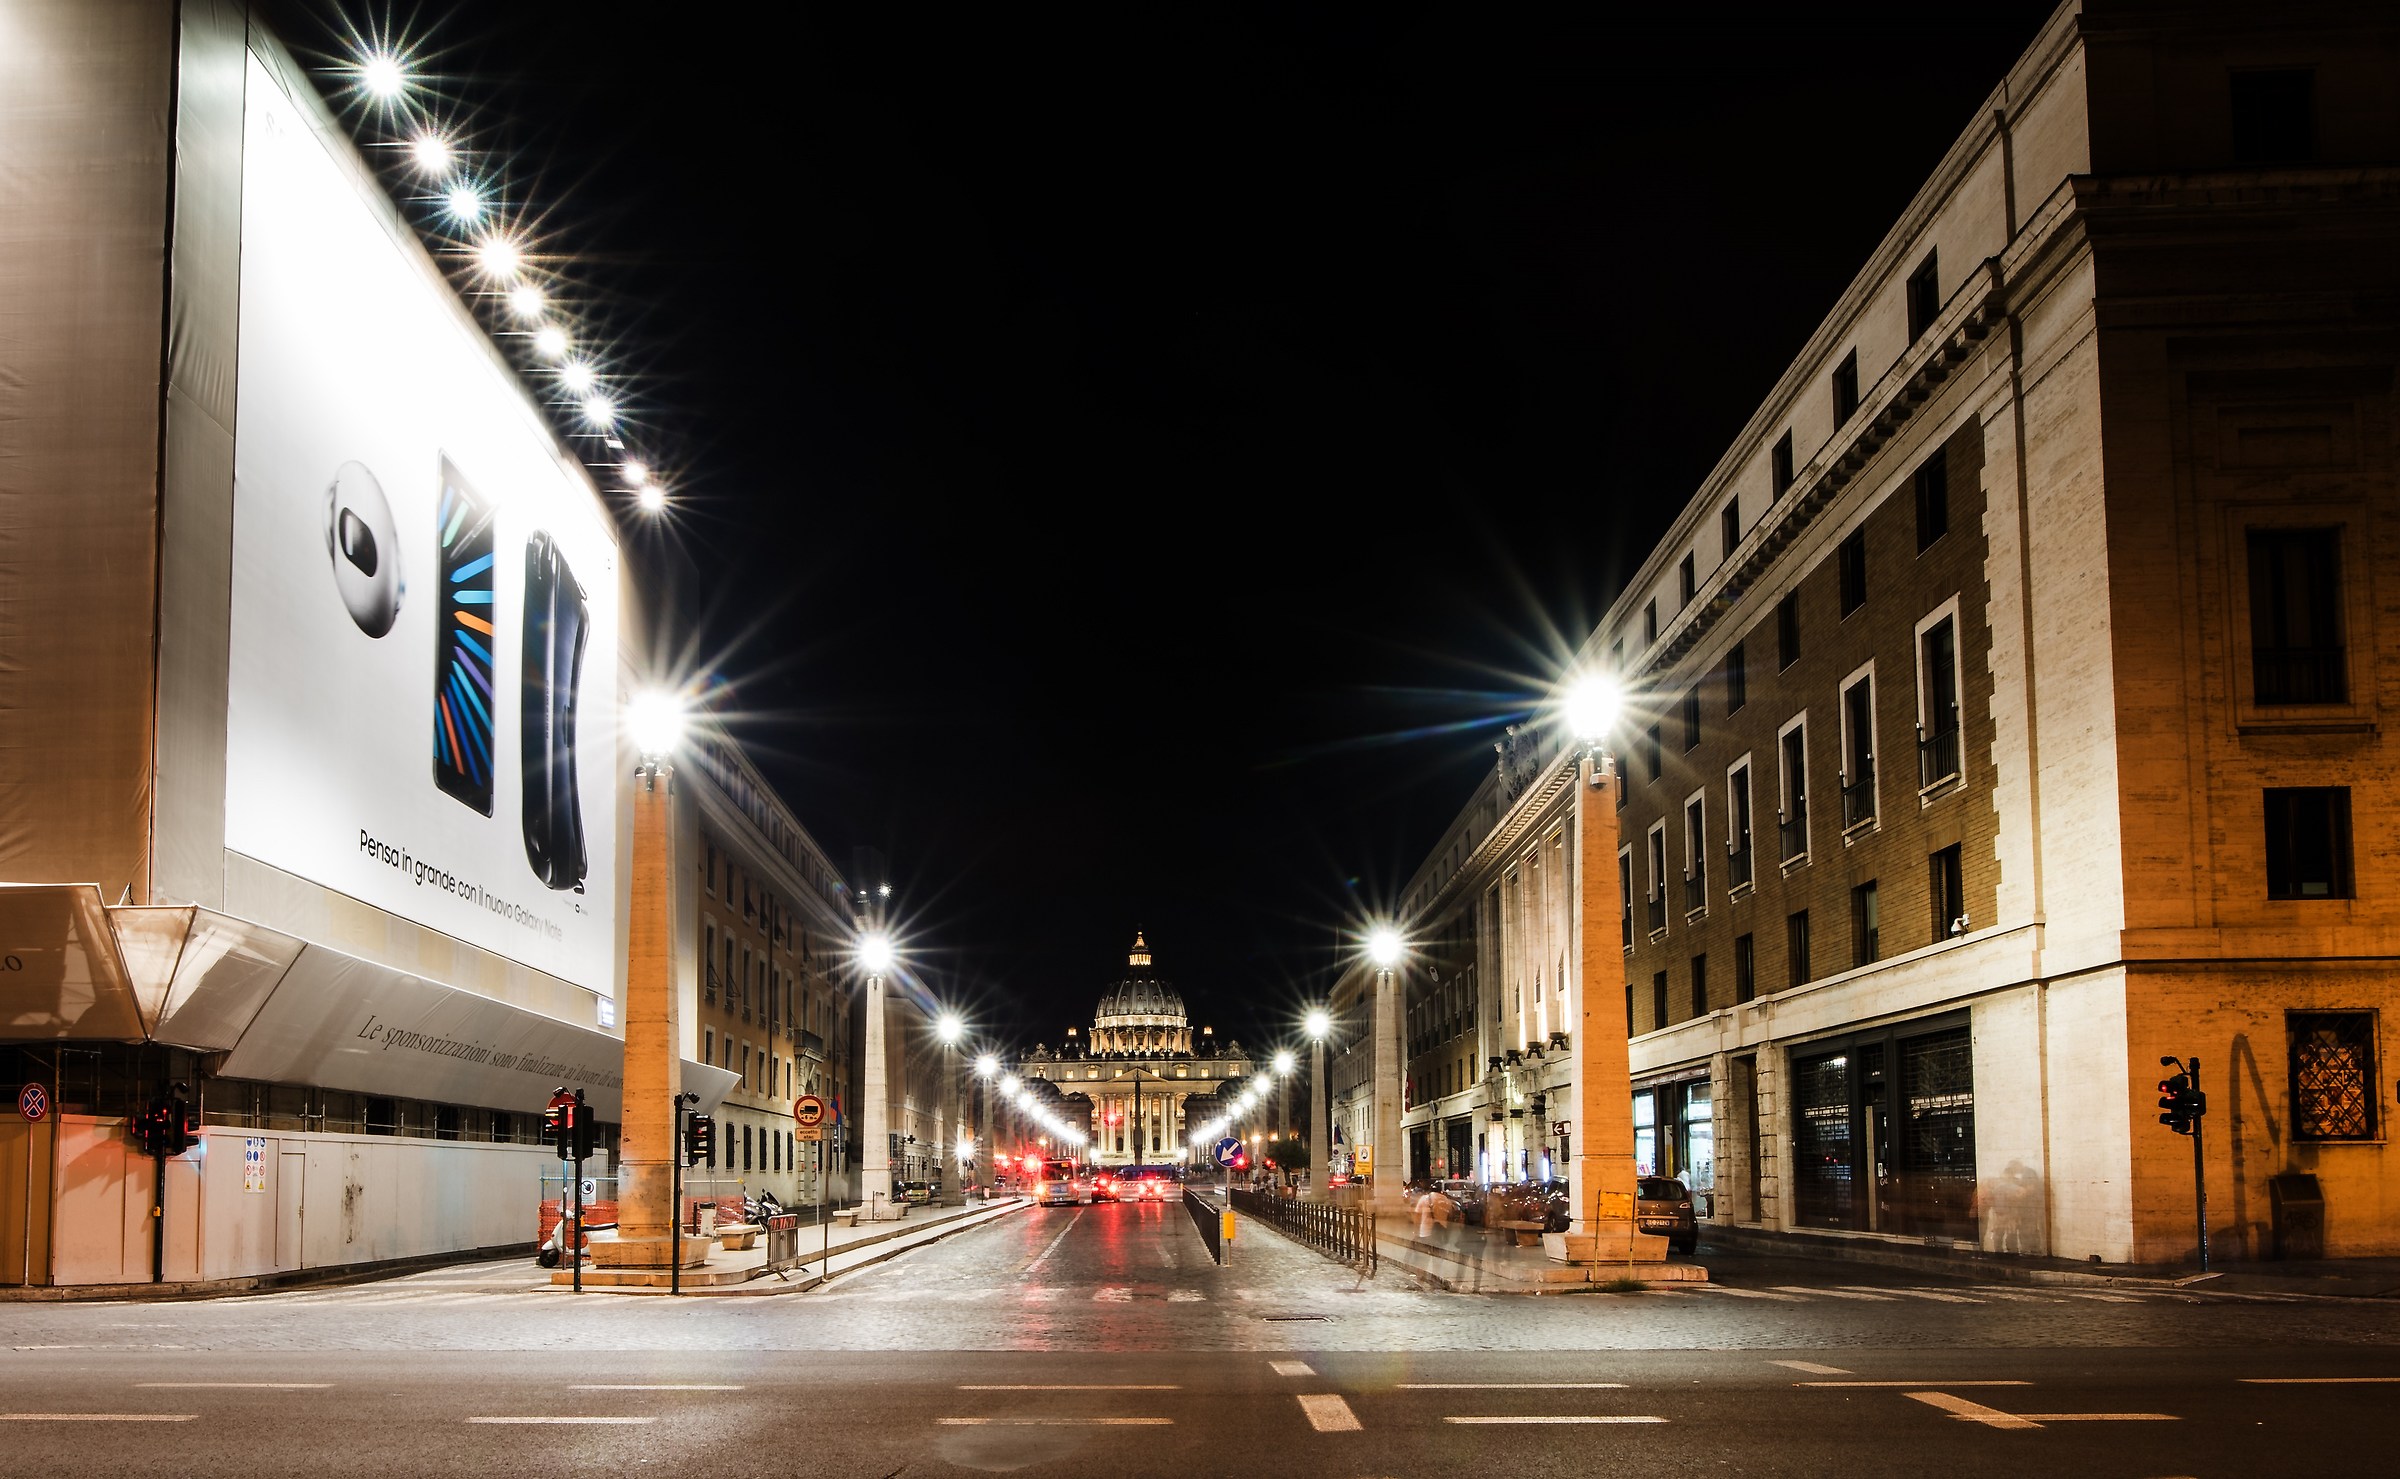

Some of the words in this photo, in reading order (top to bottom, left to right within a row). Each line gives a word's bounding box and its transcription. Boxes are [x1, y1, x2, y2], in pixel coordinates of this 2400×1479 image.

[360, 829, 399, 868] Pensa
[402, 847, 413, 875] in
[414, 860, 456, 893] grande
[457, 880, 477, 904] con
[478, 884, 484, 907] il
[485, 892, 513, 919] nuovo
[514, 903, 544, 939] Galaxy
[544, 918, 563, 942] Note
[357, 1015, 383, 1040] Le
[381, 1026, 496, 1063] sponsorizzazioni
[489, 1051, 518, 1069] sono
[515, 1052, 567, 1078] finalizzate
[564, 1064, 580, 1080] ai
[574, 1064, 605, 1083] lavori
